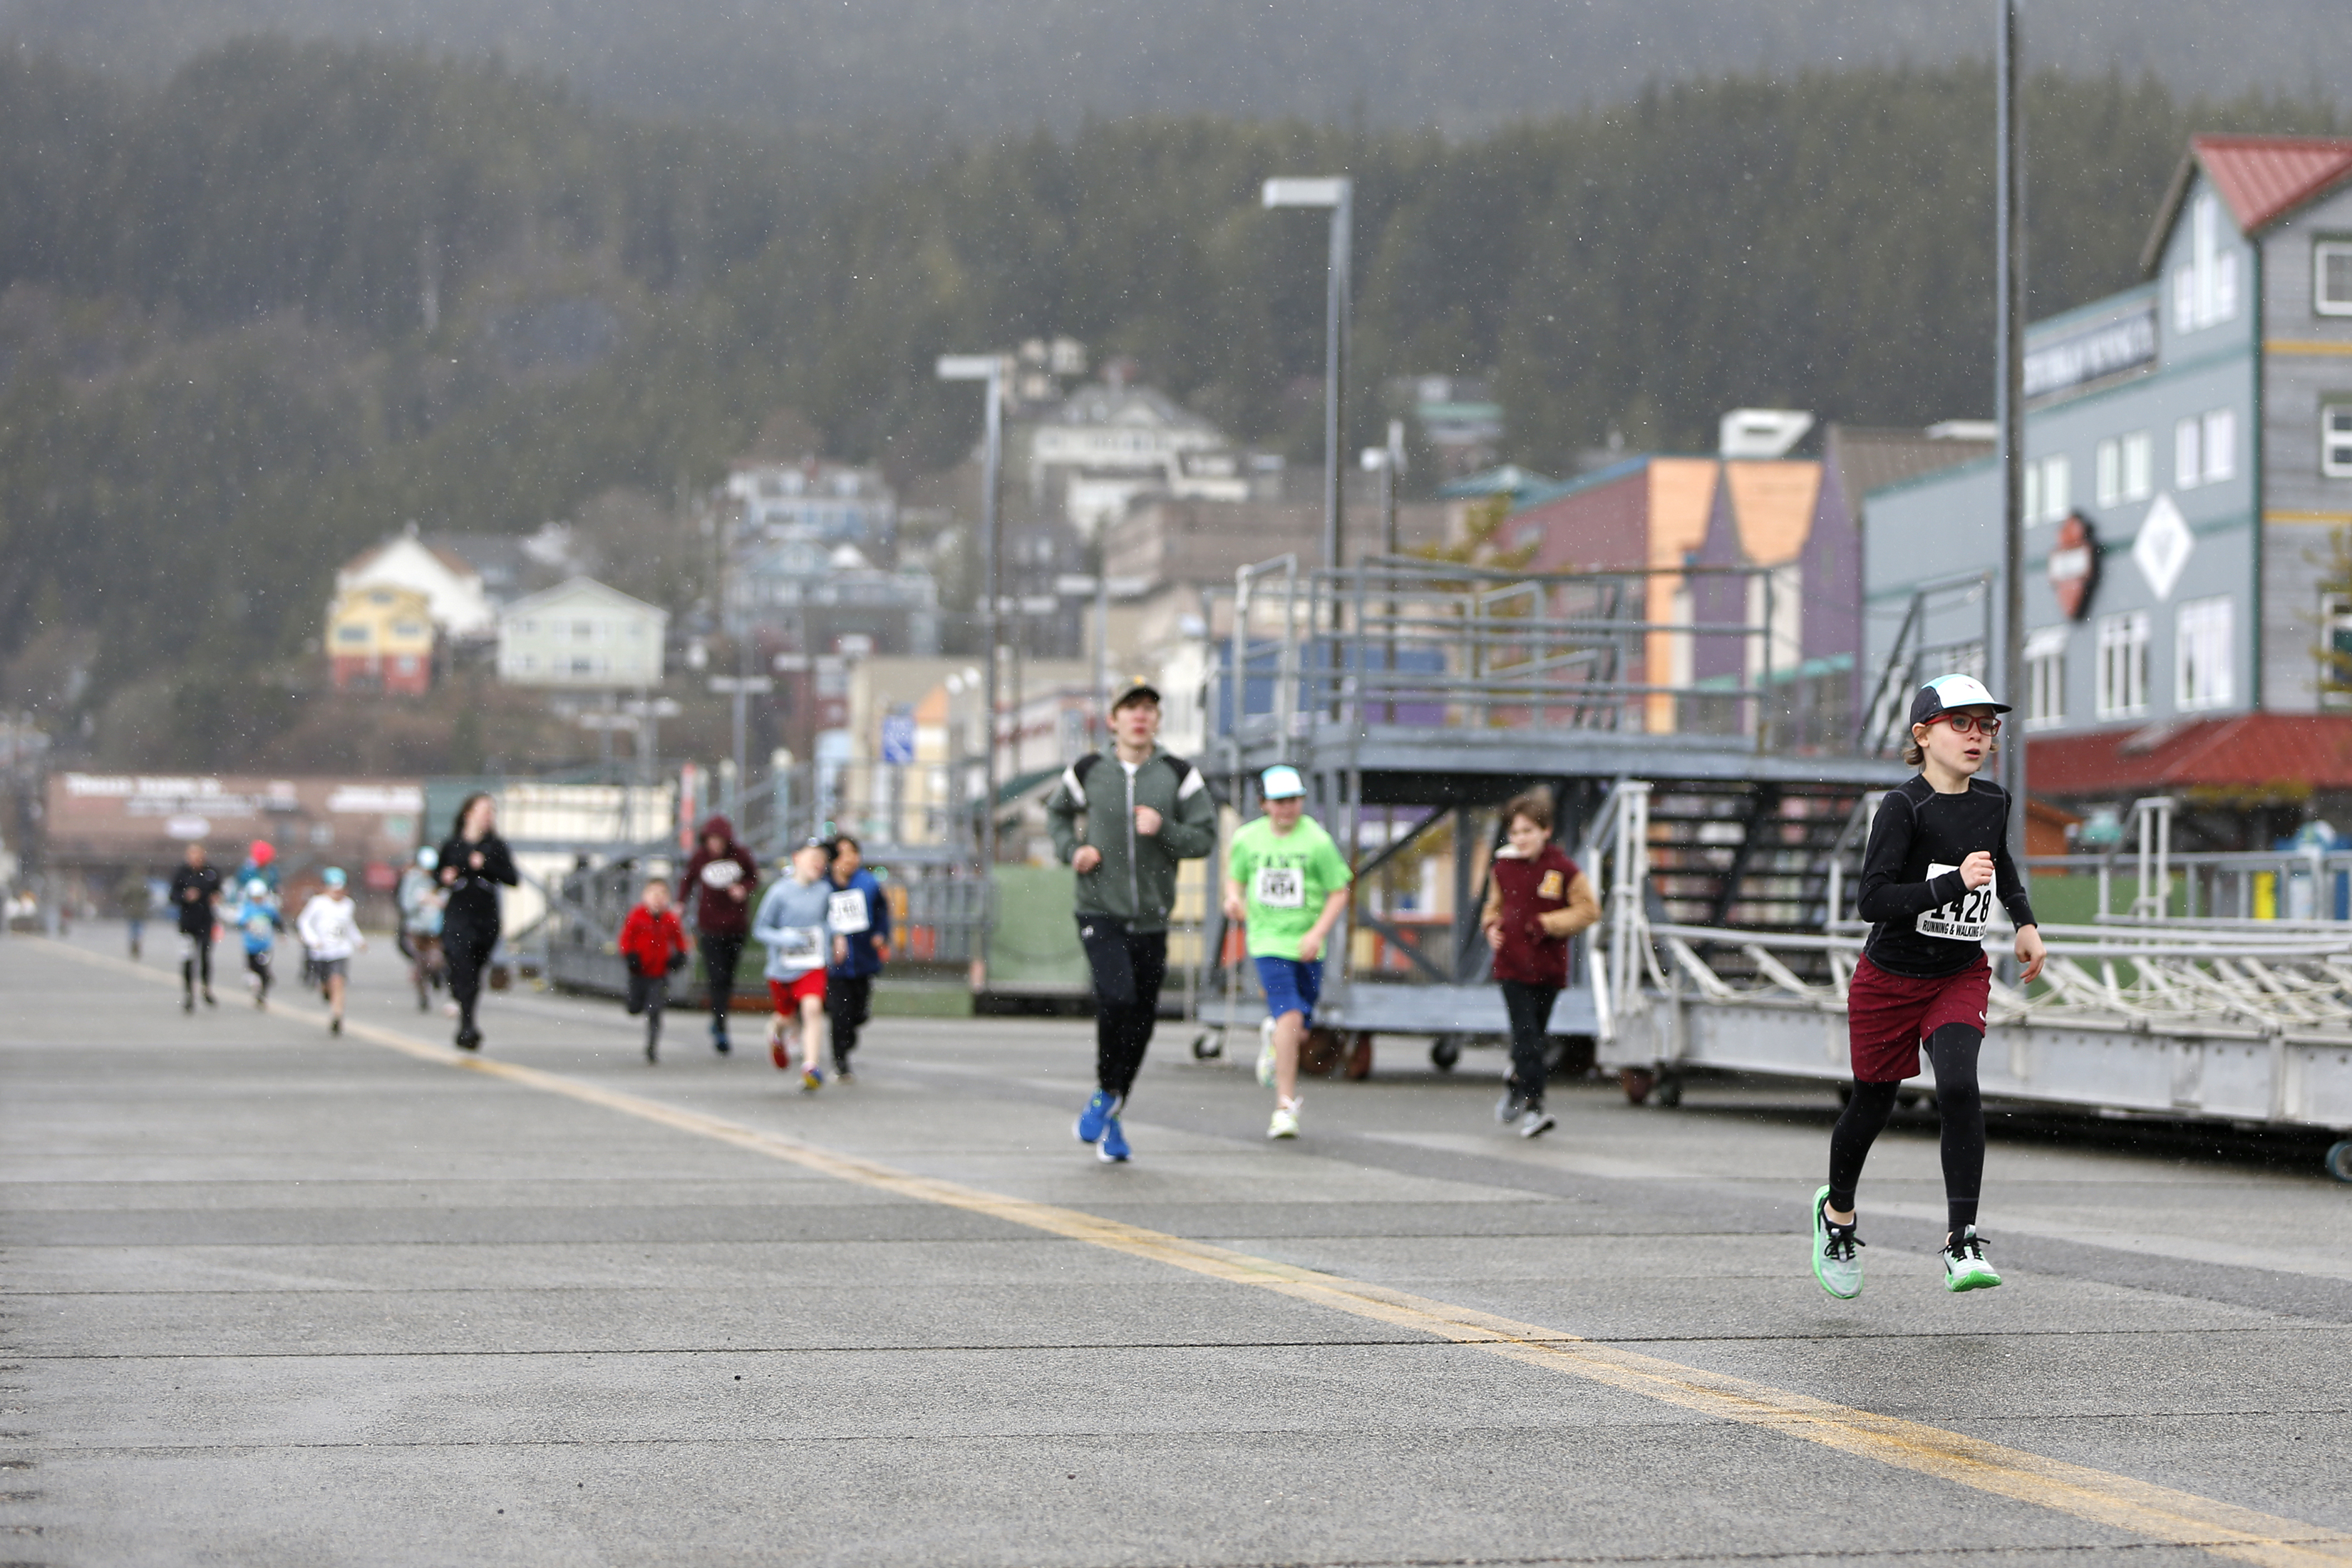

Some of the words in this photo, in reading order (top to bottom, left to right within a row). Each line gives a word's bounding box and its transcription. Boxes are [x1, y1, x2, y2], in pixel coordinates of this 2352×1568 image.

[1922, 919, 1949, 934] RUNNING
[1949, 924, 1954, 934] &
[1956, 924, 1979, 937] WALKING
